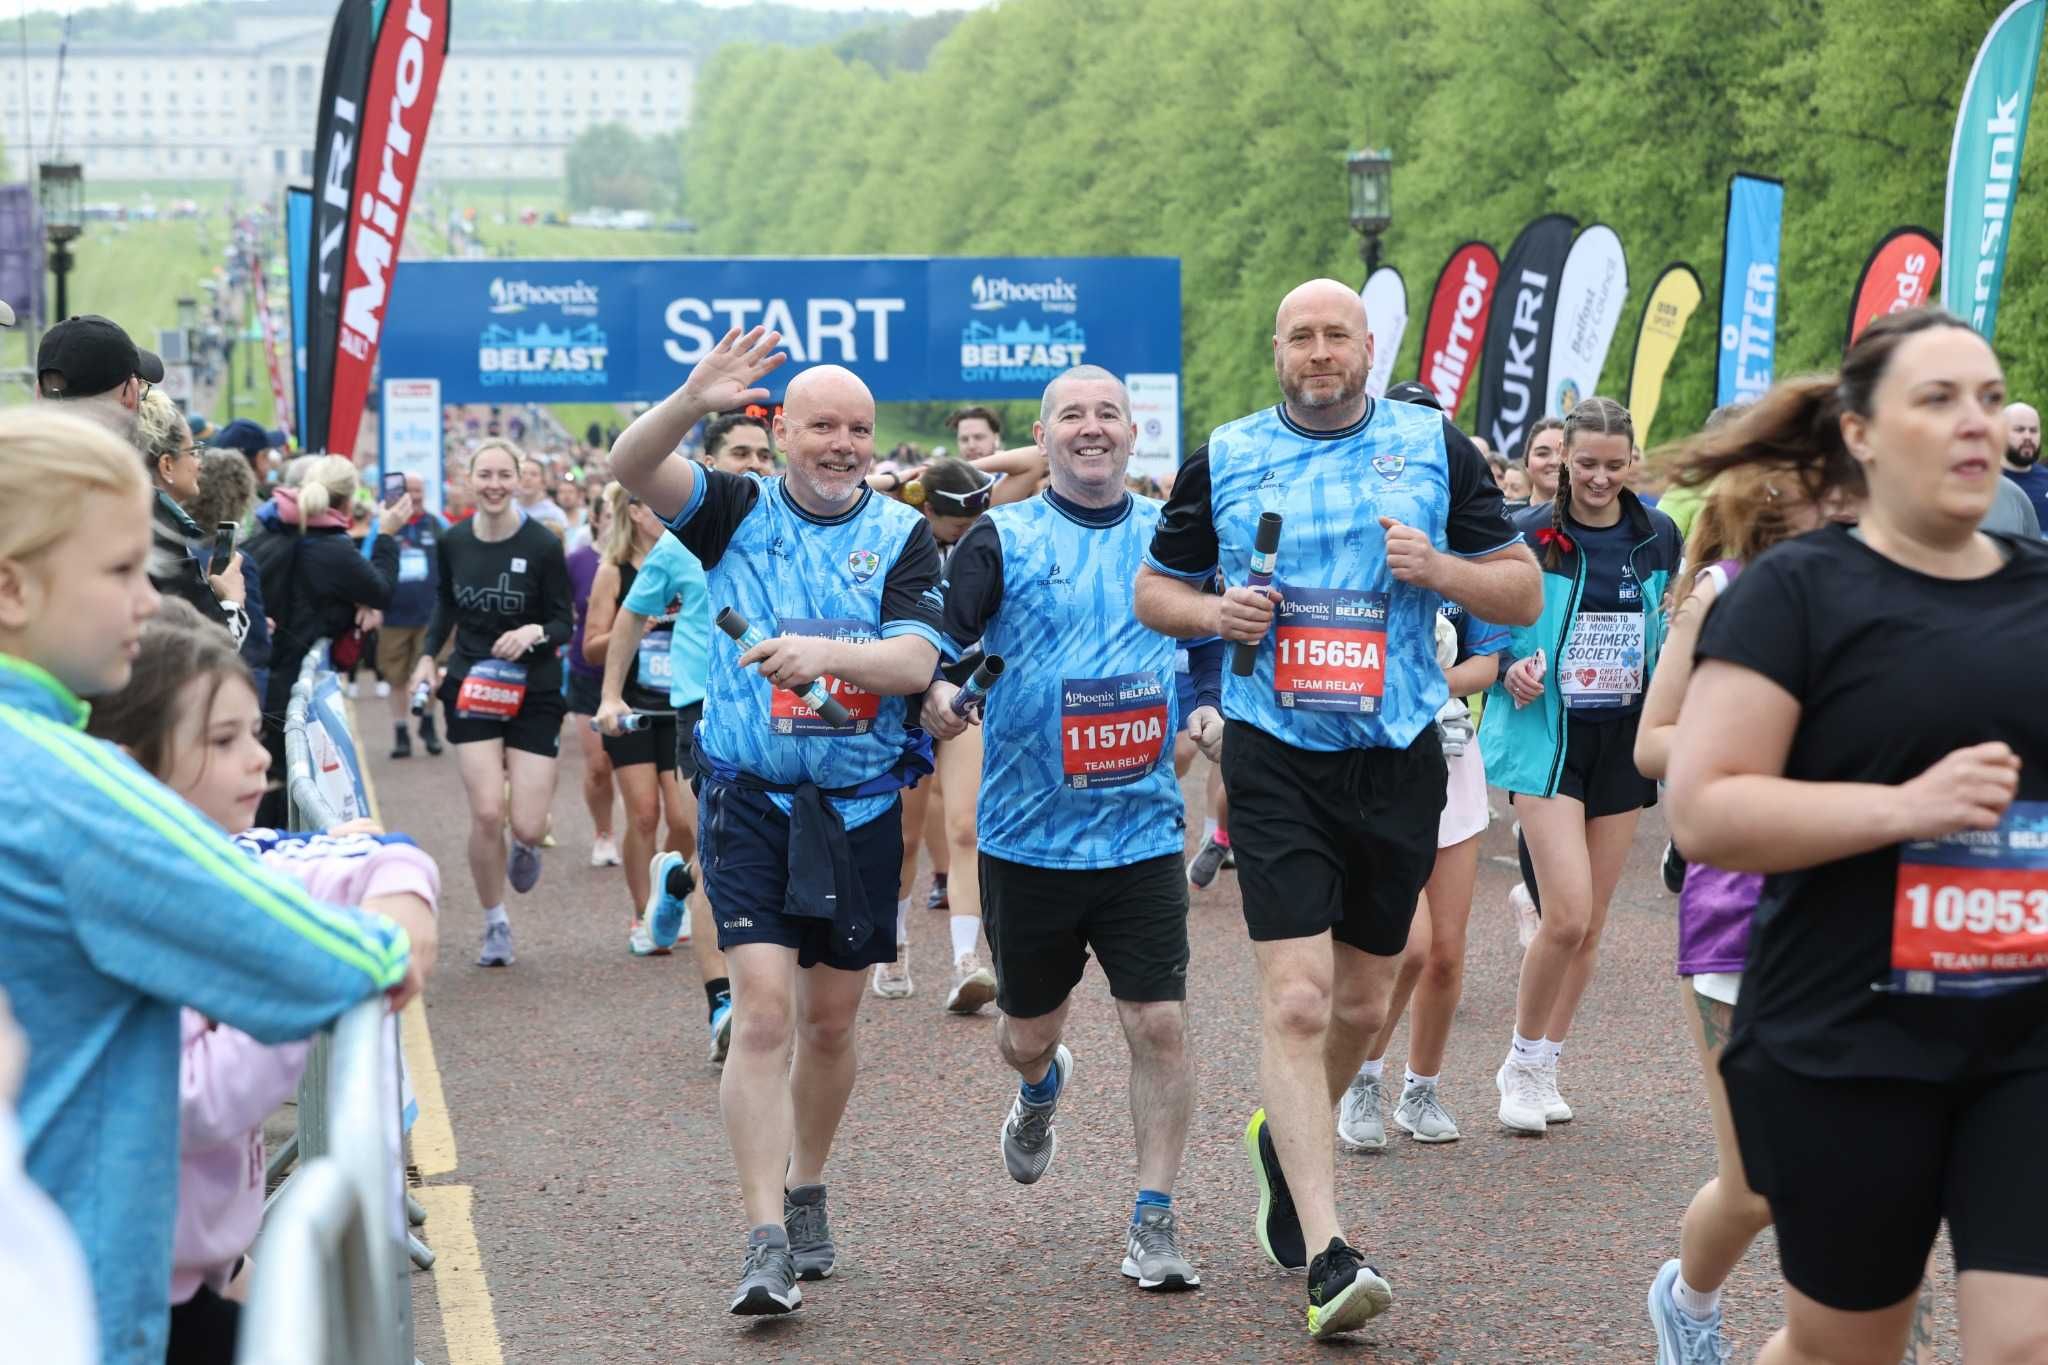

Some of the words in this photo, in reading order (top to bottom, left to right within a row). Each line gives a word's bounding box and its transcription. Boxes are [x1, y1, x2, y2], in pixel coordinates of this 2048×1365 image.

[506, 280, 598, 304] Phoenix
[988, 277, 1077, 301] Phoenix
[663, 297, 906, 364] START
[479, 347, 608, 371] BELFAST
[961, 343, 1086, 367] BELFAST
[1492, 269, 1548, 458] KUKRI
[1286, 600, 1330, 614] Phoenix
[1335, 606, 1385, 619] BELFAST
[1586, 614, 1618, 623] RUNNING
[1620, 615, 1629, 623] TO
[1589, 623, 1621, 633] MONEY
[1622, 624, 1637, 633] FOR
[1568, 633, 1641, 647] ZHEIMER'S
[1280, 638, 1380, 670] 11565A
[1567, 647, 1622, 660] SOCIETY
[1119, 686, 1161, 700] BELFAST
[1291, 679, 1323, 690] TEAM
[1325, 681, 1366, 692] RELAY
[1072, 691, 1115, 704] Phoenix
[1067, 717, 1162, 751] 11570A
[1084, 760, 1116, 771] TEAM
[1118, 752, 1150, 769] RELAY
[1906, 883, 2048, 935] 10953
[1930, 951, 1988, 969] TEAM
